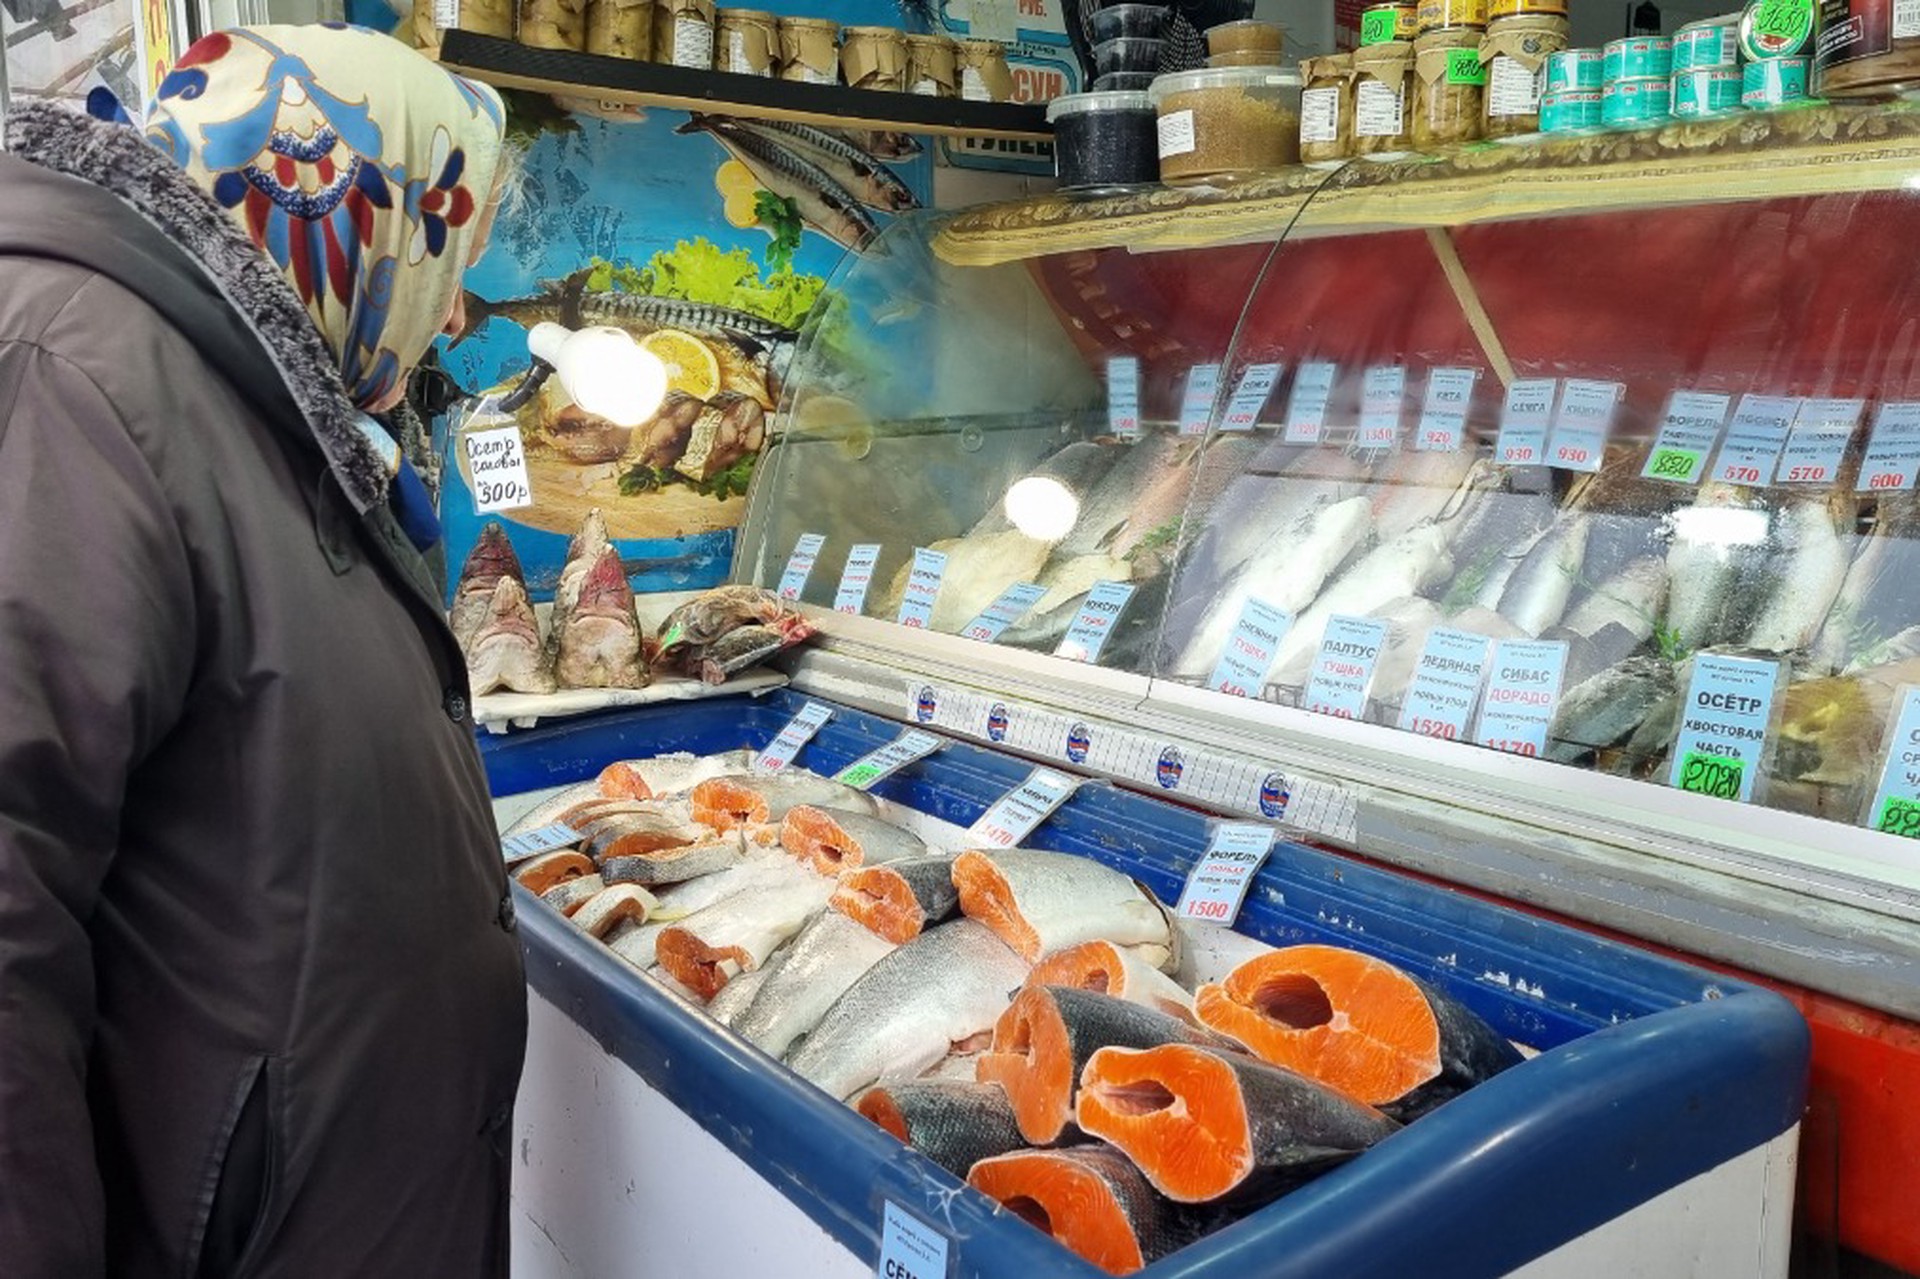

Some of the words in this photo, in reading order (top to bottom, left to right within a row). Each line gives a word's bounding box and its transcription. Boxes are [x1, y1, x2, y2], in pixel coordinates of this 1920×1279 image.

[1666, 414, 1720, 429] ФОРЕЛЬ
[1427, 431, 1451, 444] 920
[1505, 447, 1533, 461] 930
[1557, 447, 1588, 463] 930
[1724, 465, 1760, 482] 570
[1788, 466, 1825, 481] 570
[1869, 473, 1904, 488] 600
[1234, 637, 1268, 660] ТУШКА
[1323, 639, 1376, 659] ПАЛТУС
[1323, 660, 1364, 678] ТУШКА
[1421, 653, 1482, 676] ЛЕДЯНАЯ
[1500, 666, 1550, 683] СИБАС
[1489, 688, 1551, 706] ДОРАДО
[1697, 691, 1762, 713] ОСЁТР
[1411, 715, 1457, 741] 1520
[1684, 719, 1764, 741] ХВОСТОВАЯ
[1486, 738, 1537, 757] 1170
[1695, 741, 1742, 758] ЧАСТЬ
[1208, 849, 1259, 863] ФОРЕЛЬ
[1187, 899, 1229, 918] 1500
